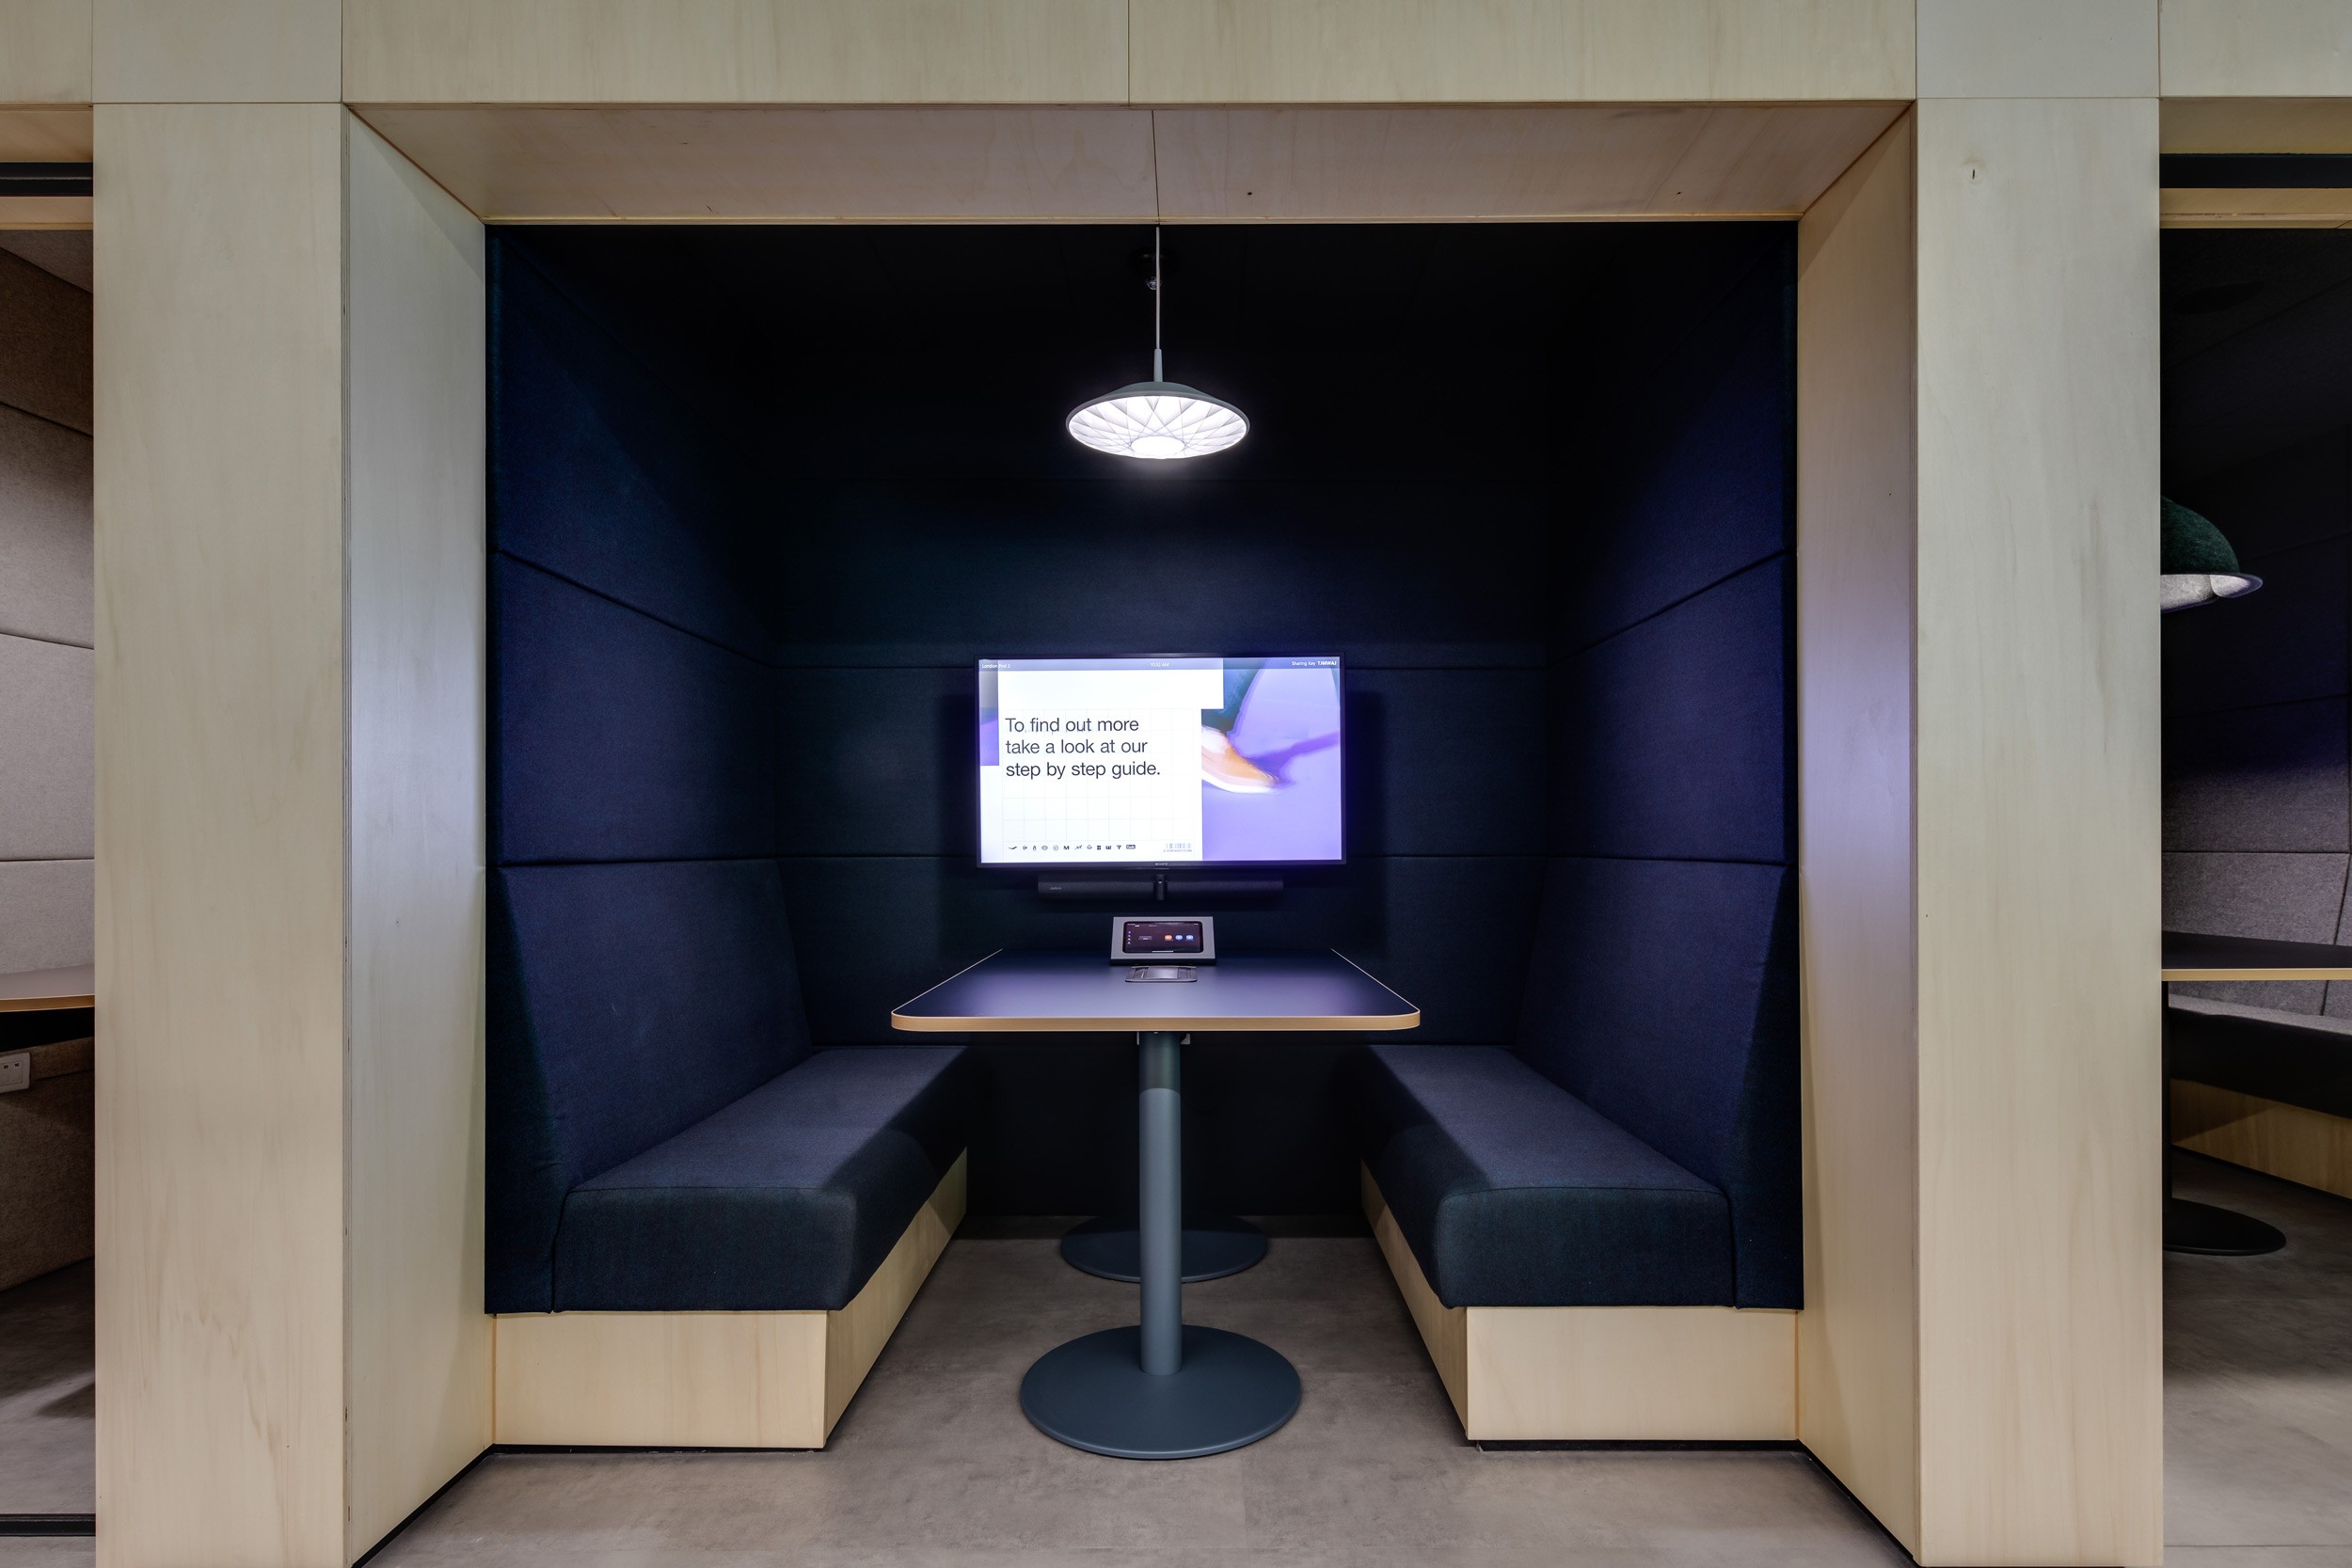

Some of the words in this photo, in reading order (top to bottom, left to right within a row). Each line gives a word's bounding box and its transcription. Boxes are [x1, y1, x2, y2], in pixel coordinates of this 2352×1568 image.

[1005, 718, 1025, 732] To
[1029, 717, 1060, 732] find
[1065, 718, 1092, 732] out
[1097, 720, 1139, 732] more
[1005, 739, 1040, 754] take
[1044, 742, 1056, 754] a
[1060, 738, 1095, 753] look
[1101, 740, 1116, 753] at
[1120, 741, 1148, 753] our
[1005, 762, 1041, 780] step
[1046, 761, 1066, 780] by
[1071, 762, 1106, 779] step
[1111, 760, 1161, 779] guide.
